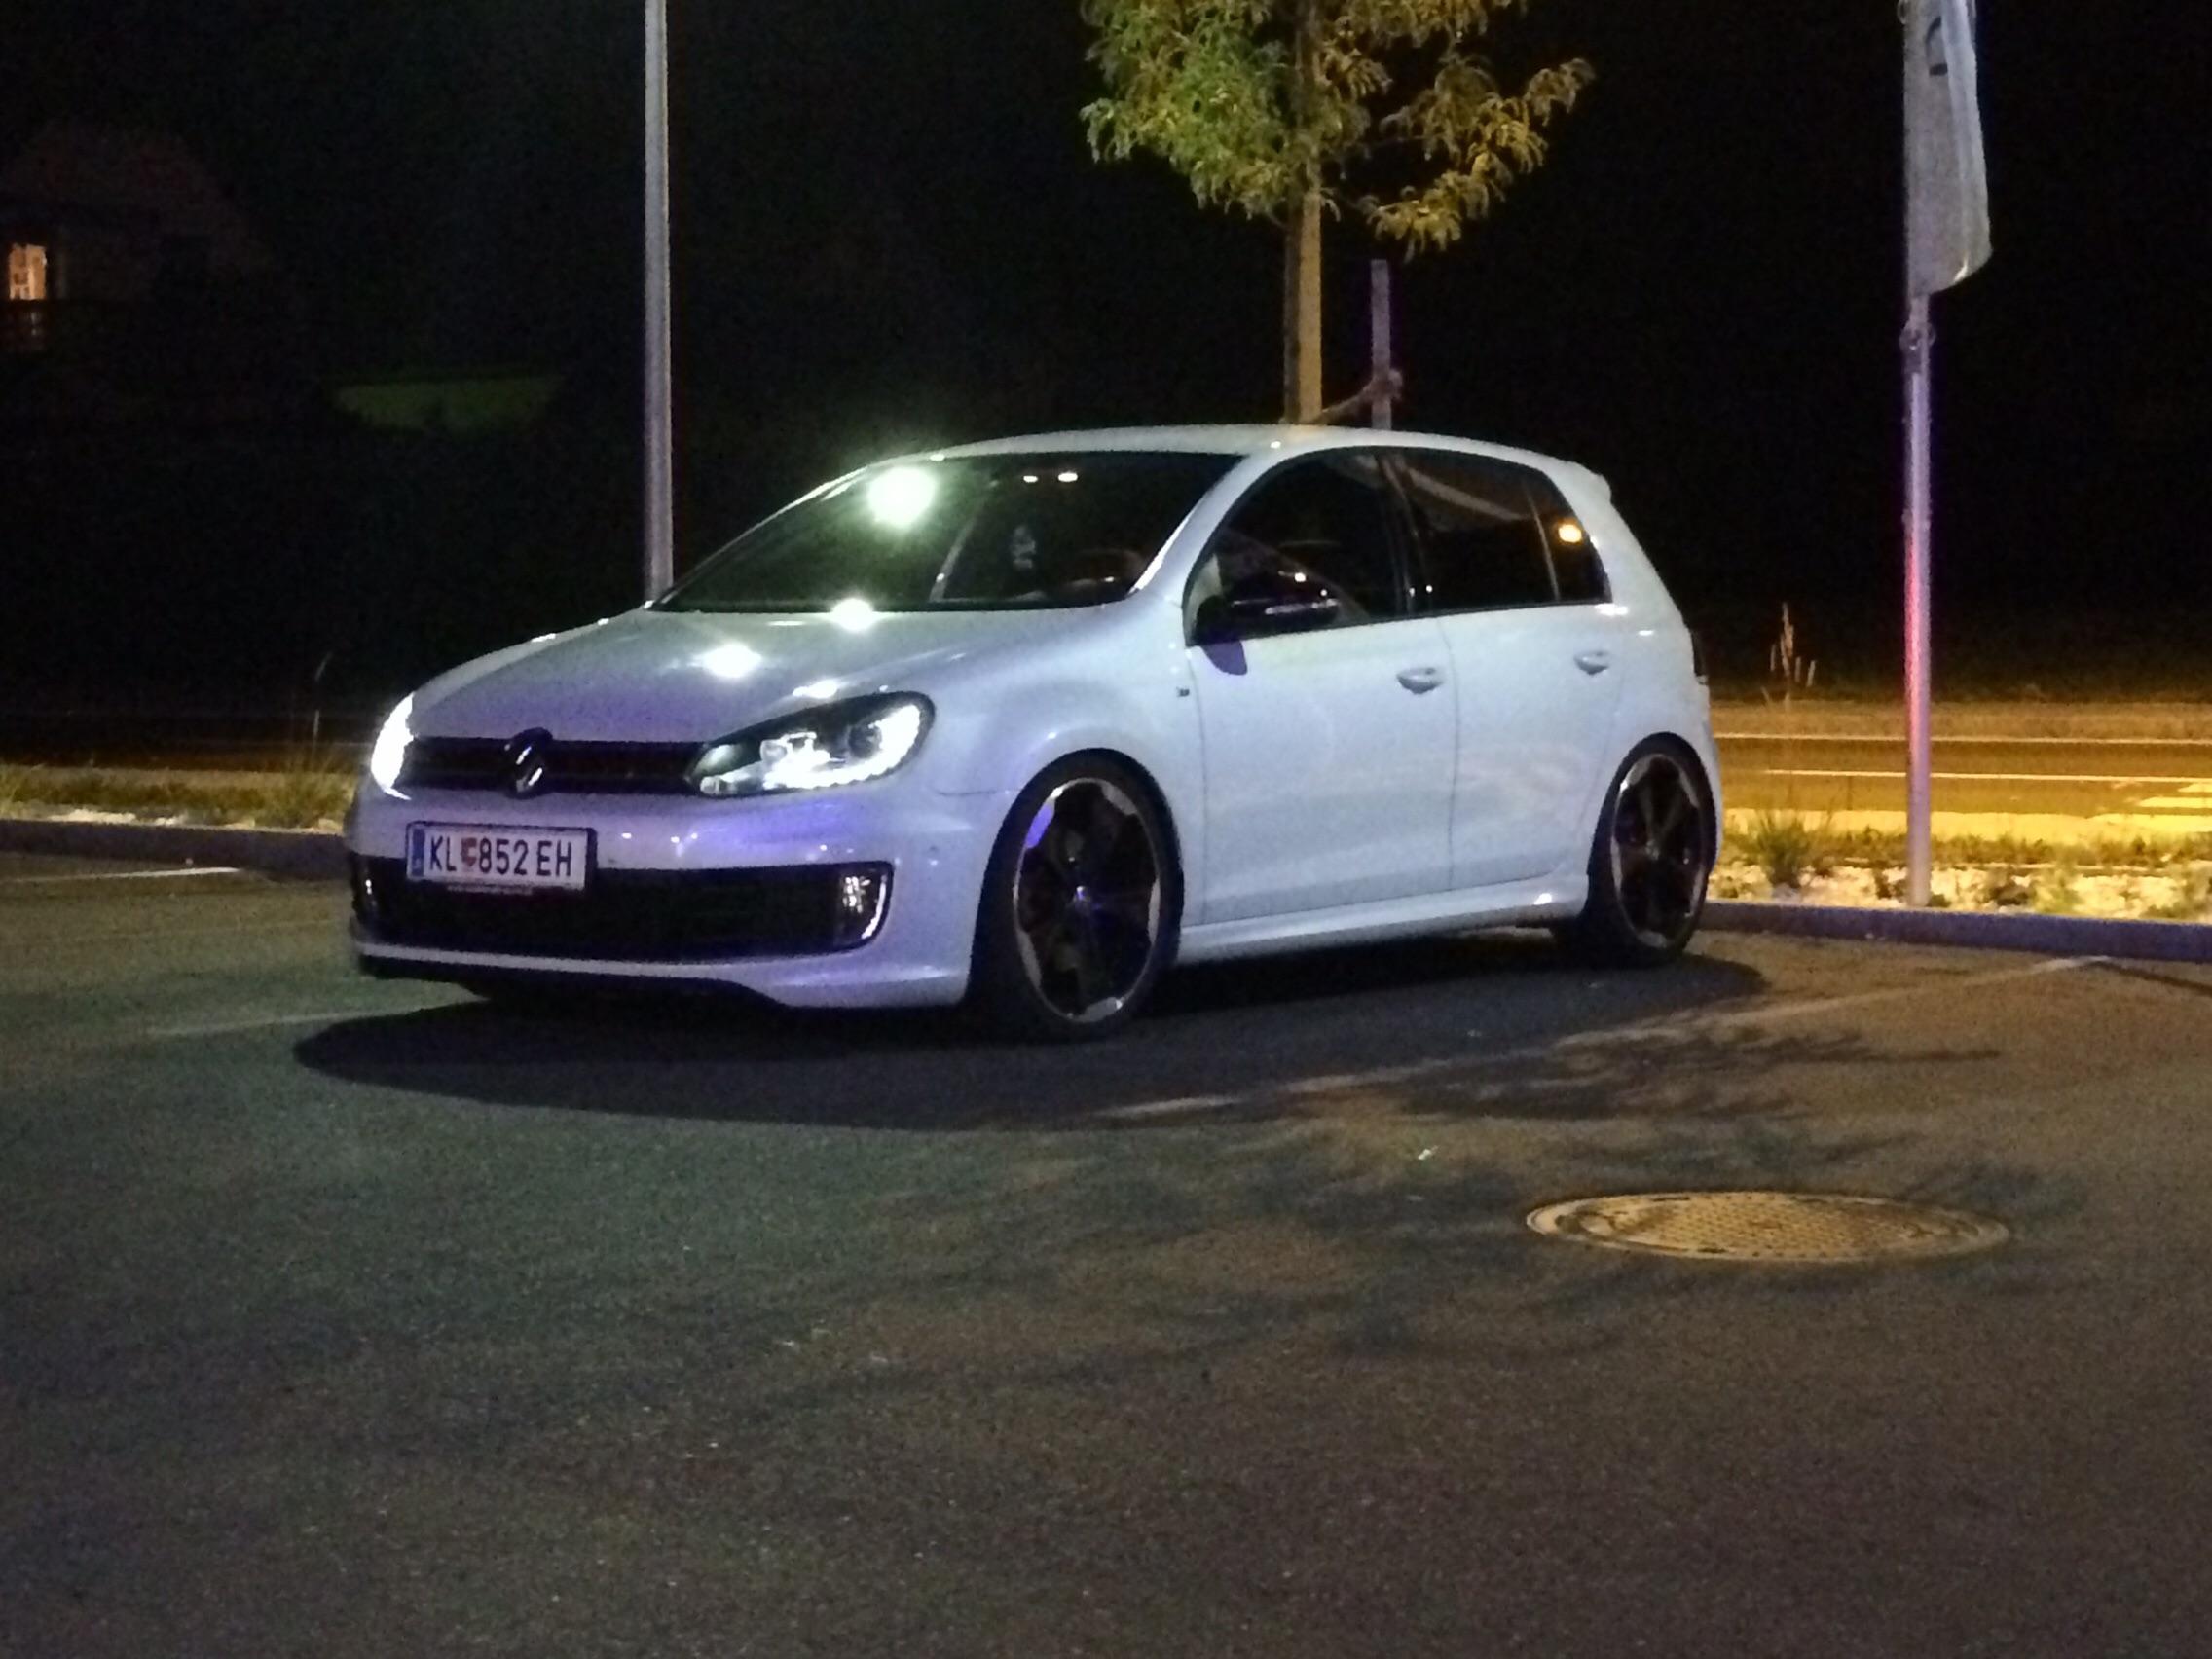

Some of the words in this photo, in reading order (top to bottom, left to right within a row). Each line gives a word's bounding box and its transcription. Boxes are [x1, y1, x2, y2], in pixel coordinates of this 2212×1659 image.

[429, 835, 457, 872] KL
[478, 837, 529, 875] 852
[536, 840, 572, 876] EH
